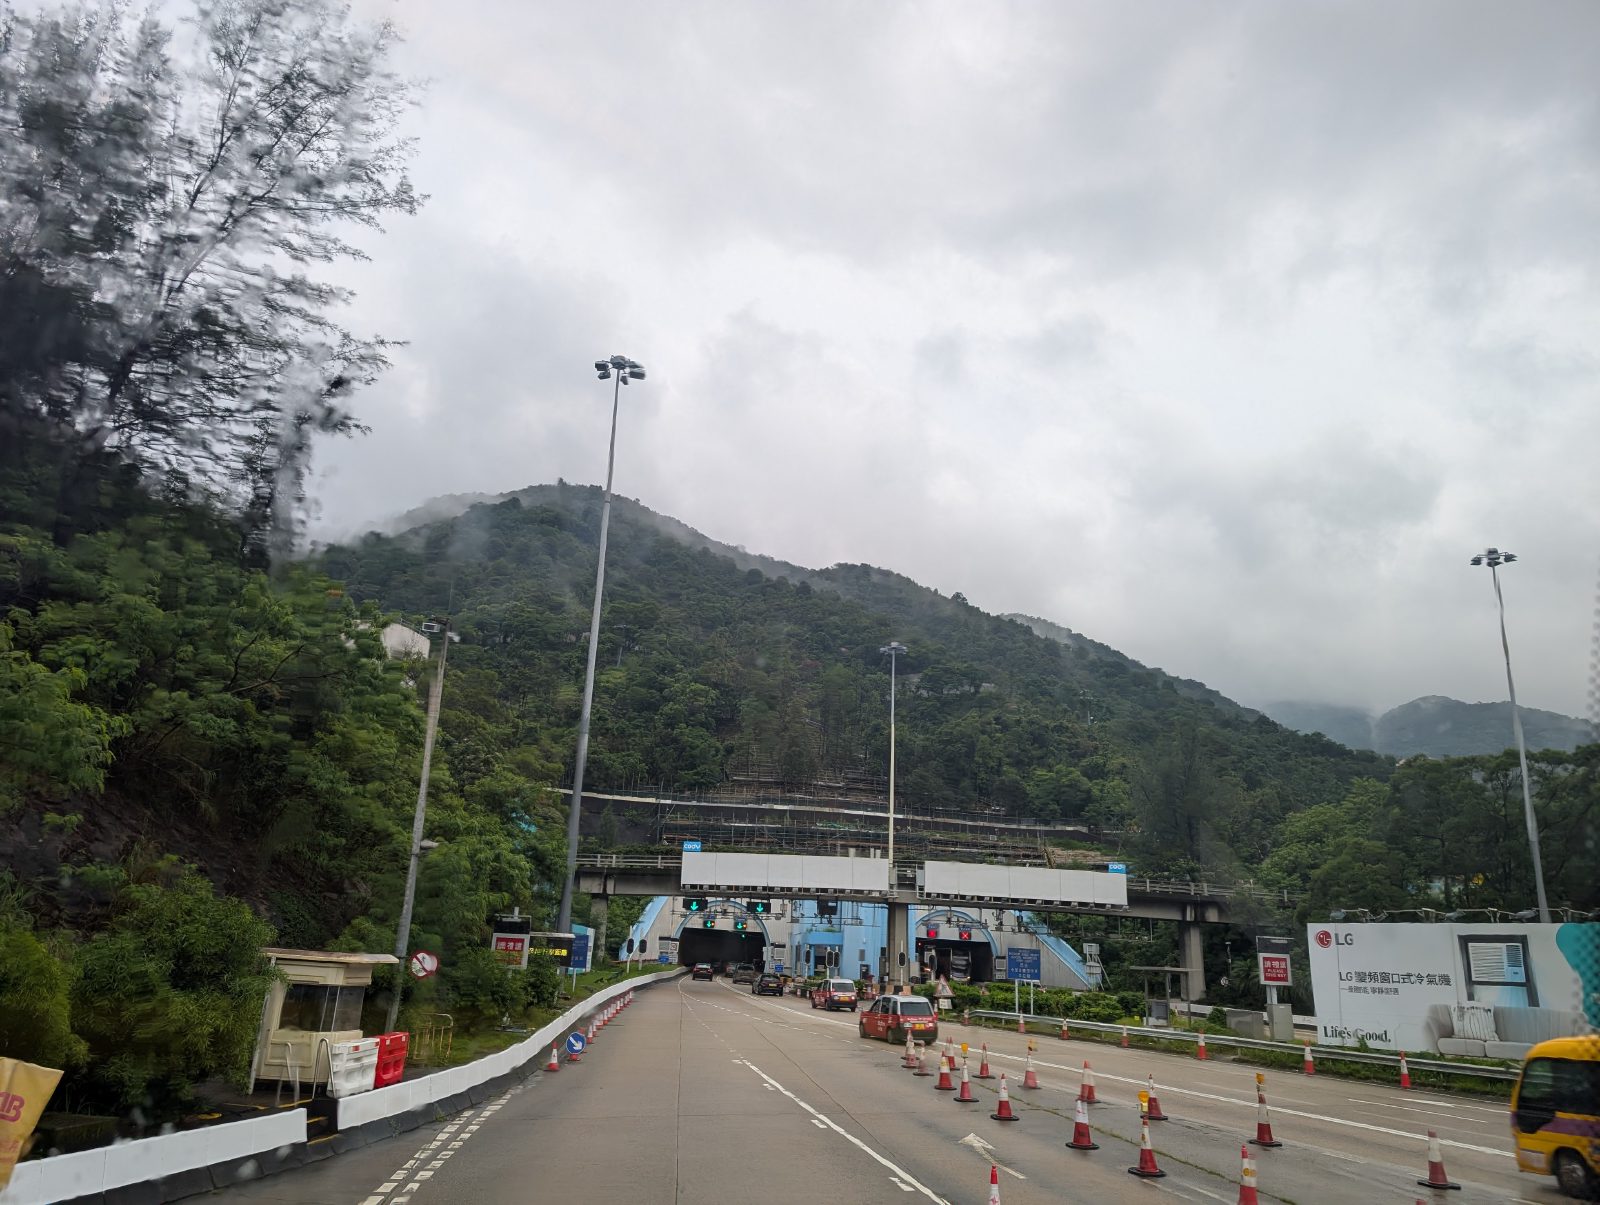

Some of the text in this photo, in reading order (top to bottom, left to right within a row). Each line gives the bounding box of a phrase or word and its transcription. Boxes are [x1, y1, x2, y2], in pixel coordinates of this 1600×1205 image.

[1334, 932, 1353, 946] LG
[1339, 971, 1452, 987] LG 變頻窗口式冷氣機
[1323, 1025, 1352, 1040] Life's
